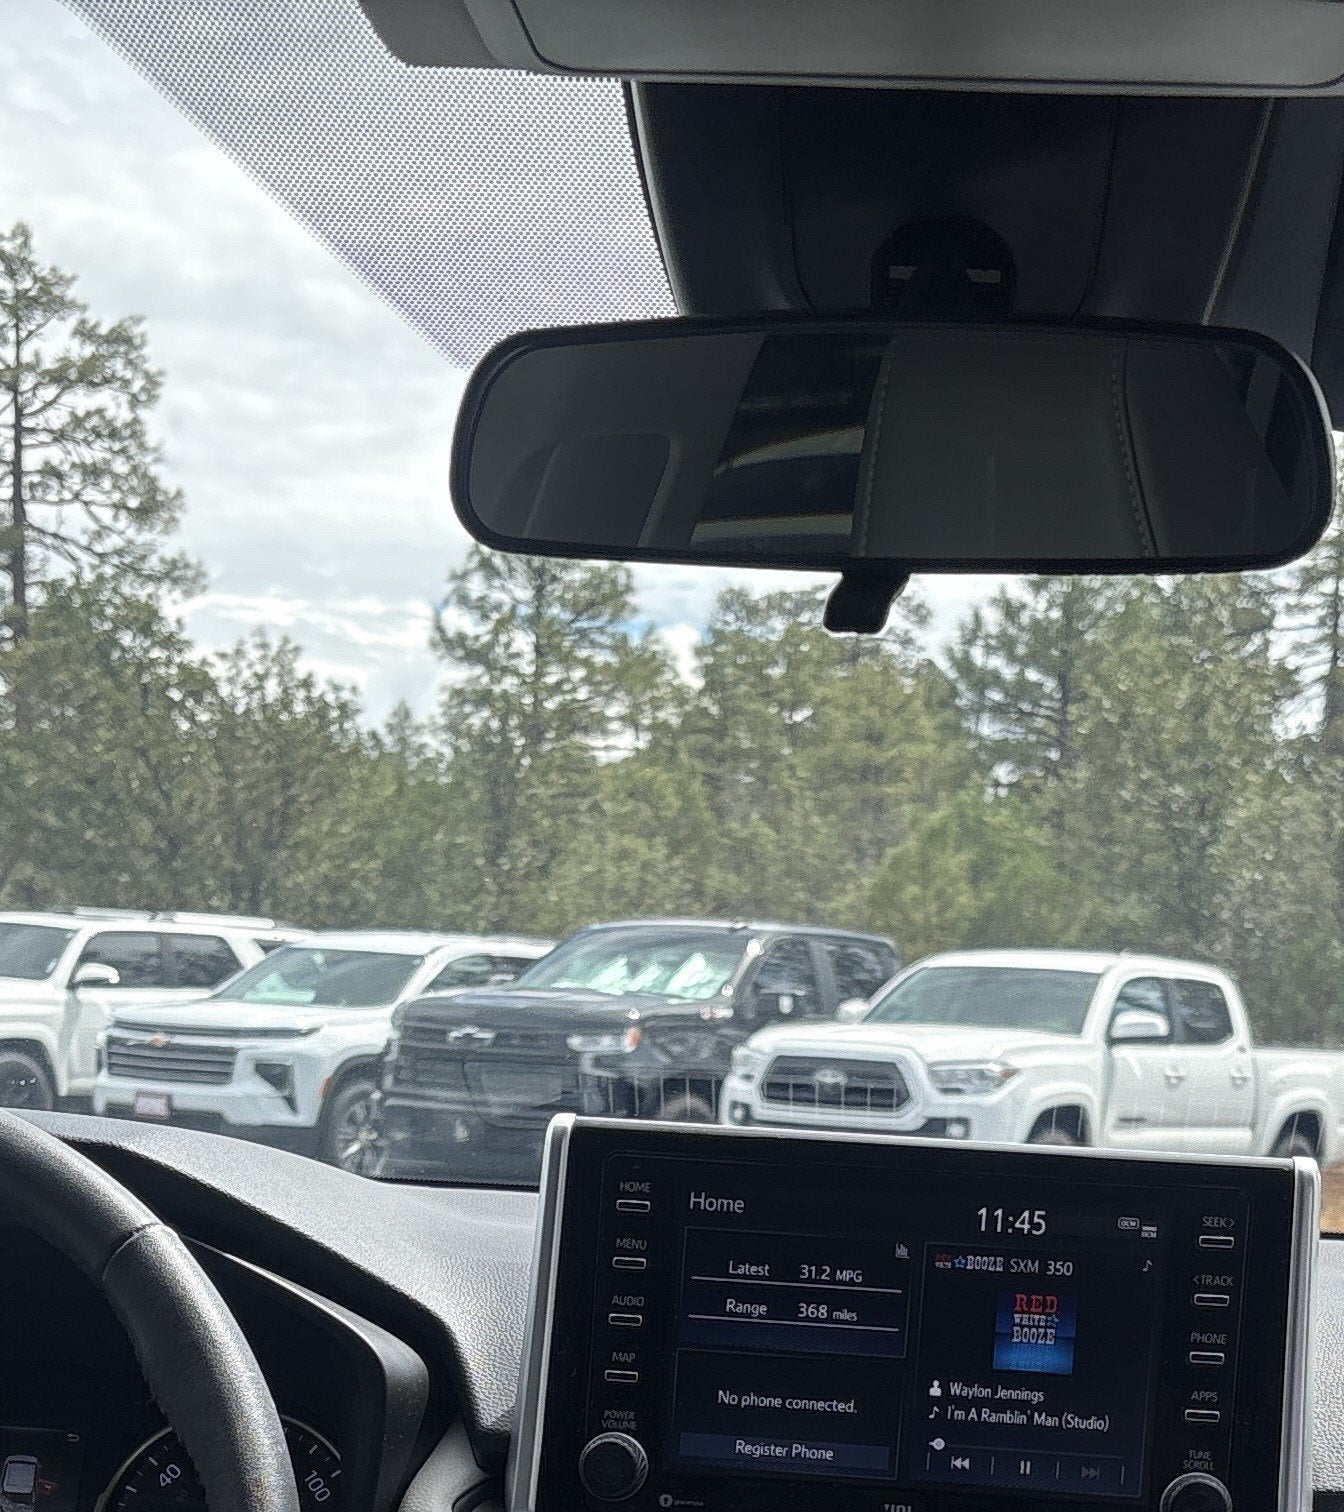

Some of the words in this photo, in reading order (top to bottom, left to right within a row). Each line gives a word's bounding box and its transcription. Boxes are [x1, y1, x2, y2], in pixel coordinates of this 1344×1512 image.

[619, 1181, 651, 1194] HOME
[689, 1191, 746, 1214] Home
[976, 1207, 1047, 1236] 11:45
[615, 1238, 648, 1251] MENU
[728, 1260, 771, 1278] Latest
[799, 1264, 831, 1281] 31.2
[835, 1269, 863, 1284] MPG
[966, 1255, 1004, 1272] BOOZE
[1009, 1258, 1040, 1274] SXM
[1045, 1261, 1074, 1276] 350
[611, 1295, 645, 1308] AUDIO
[726, 1298, 768, 1317] Range
[797, 1303, 828, 1319] 368
[832, 1309, 858, 1323] miles
[1014, 1293, 1059, 1313] RED
[1013, 1313, 1047, 1327] WHITE
[1012, 1326, 1056, 1345] BOOZE
[1190, 1332, 1227, 1345] PHONE
[611, 1351, 636, 1364] MAP
[717, 1389, 739, 1405] No
[741, 1391, 783, 1410] phone
[785, 1397, 858, 1414] connected.
[949, 1381, 991, 1401] Waylon
[994, 1384, 1046, 1404] Jennings
[1190, 1390, 1219, 1404] APPS
[601, 1418, 638, 1431] VOLUME
[603, 1409, 636, 1422] POWER
[946, 1404, 966, 1422] I'm
[967, 1407, 979, 1422] A
[981, 1407, 1032, 1426] Ramblin'
[1033, 1411, 1060, 1427] Man
[1061, 1413, 1111, 1432] (Studio)
[735, 1439, 788, 1459] Register
[791, 1443, 834, 1461] Phone
[1188, 1449, 1213, 1461] TUNE
[1182, 1458, 1215, 1471] SCROLL
[158, 1463, 182, 1488] 40
[303, 1469, 331, 1502] 100
